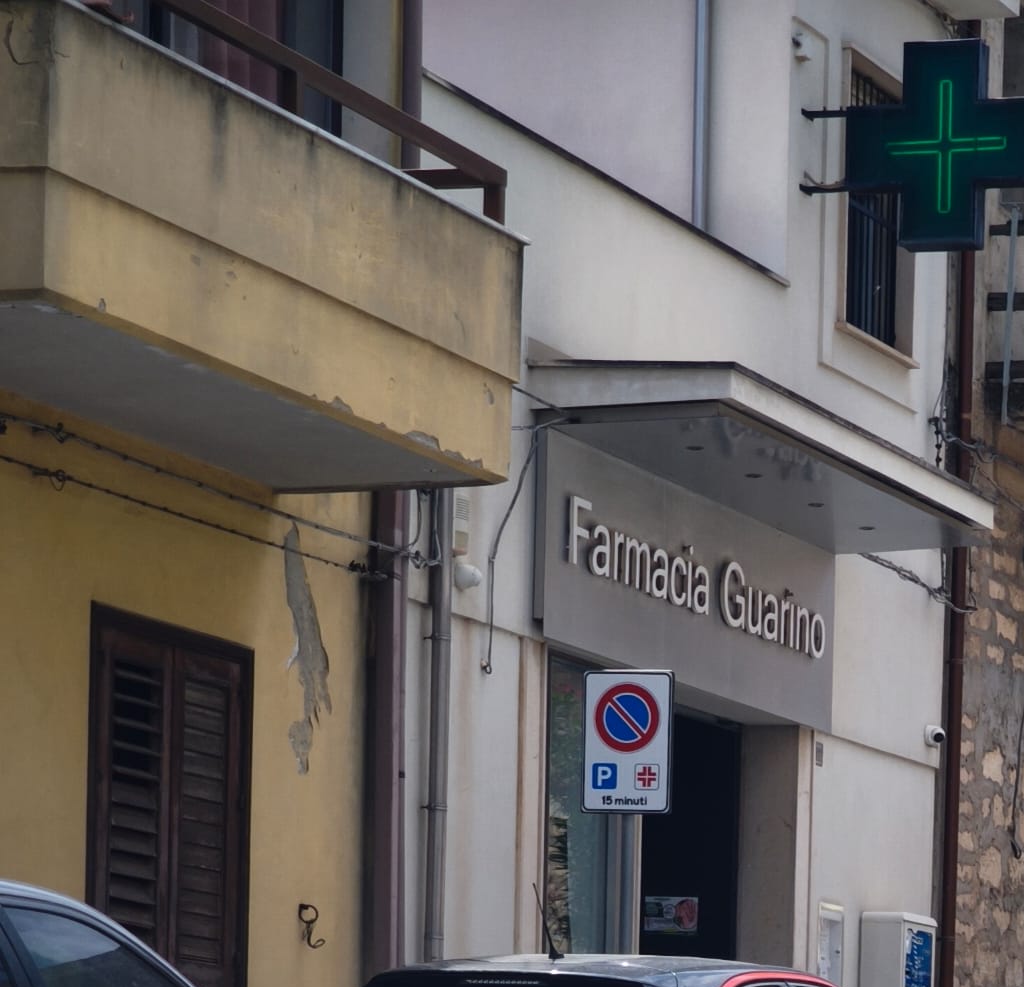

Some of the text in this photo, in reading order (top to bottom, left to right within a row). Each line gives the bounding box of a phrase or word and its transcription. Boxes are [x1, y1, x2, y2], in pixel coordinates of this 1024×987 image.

[568, 495, 826, 659] Farmacia Guarino
[597, 766, 613, 787] P
[601, 795, 648, 806] 15 minuti
